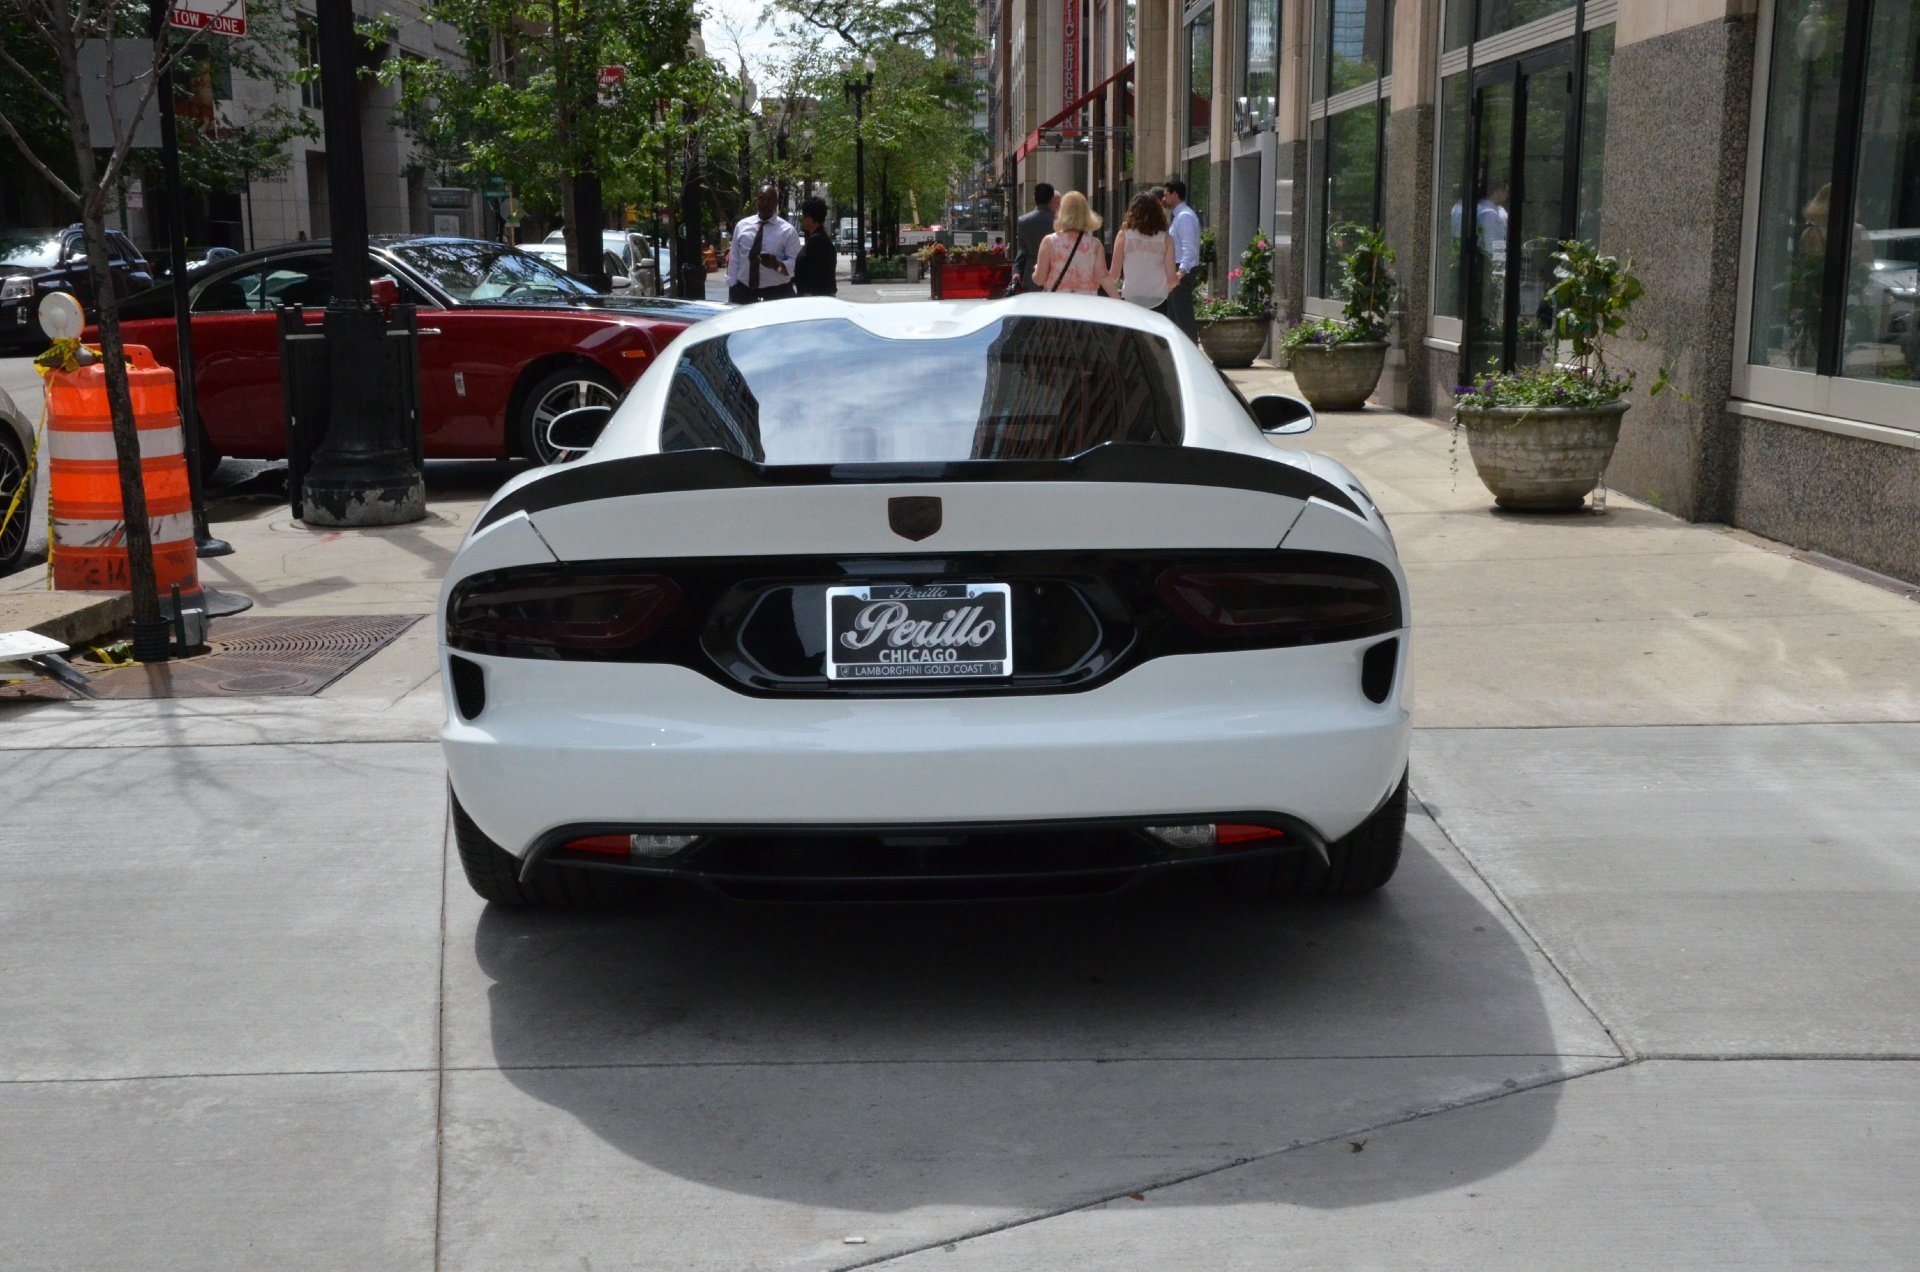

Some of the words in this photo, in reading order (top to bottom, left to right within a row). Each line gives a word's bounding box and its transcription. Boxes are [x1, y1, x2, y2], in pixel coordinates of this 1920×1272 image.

[173, 10, 200, 26] TOW
[890, 586, 948, 599] Perillo
[840, 601, 996, 649] Perillo
[878, 648, 957, 663] CHICAGO
[855, 665, 922, 676] LAMBORGHINI
[924, 664, 951, 675] GOLD
[953, 663, 983, 674] COAST
